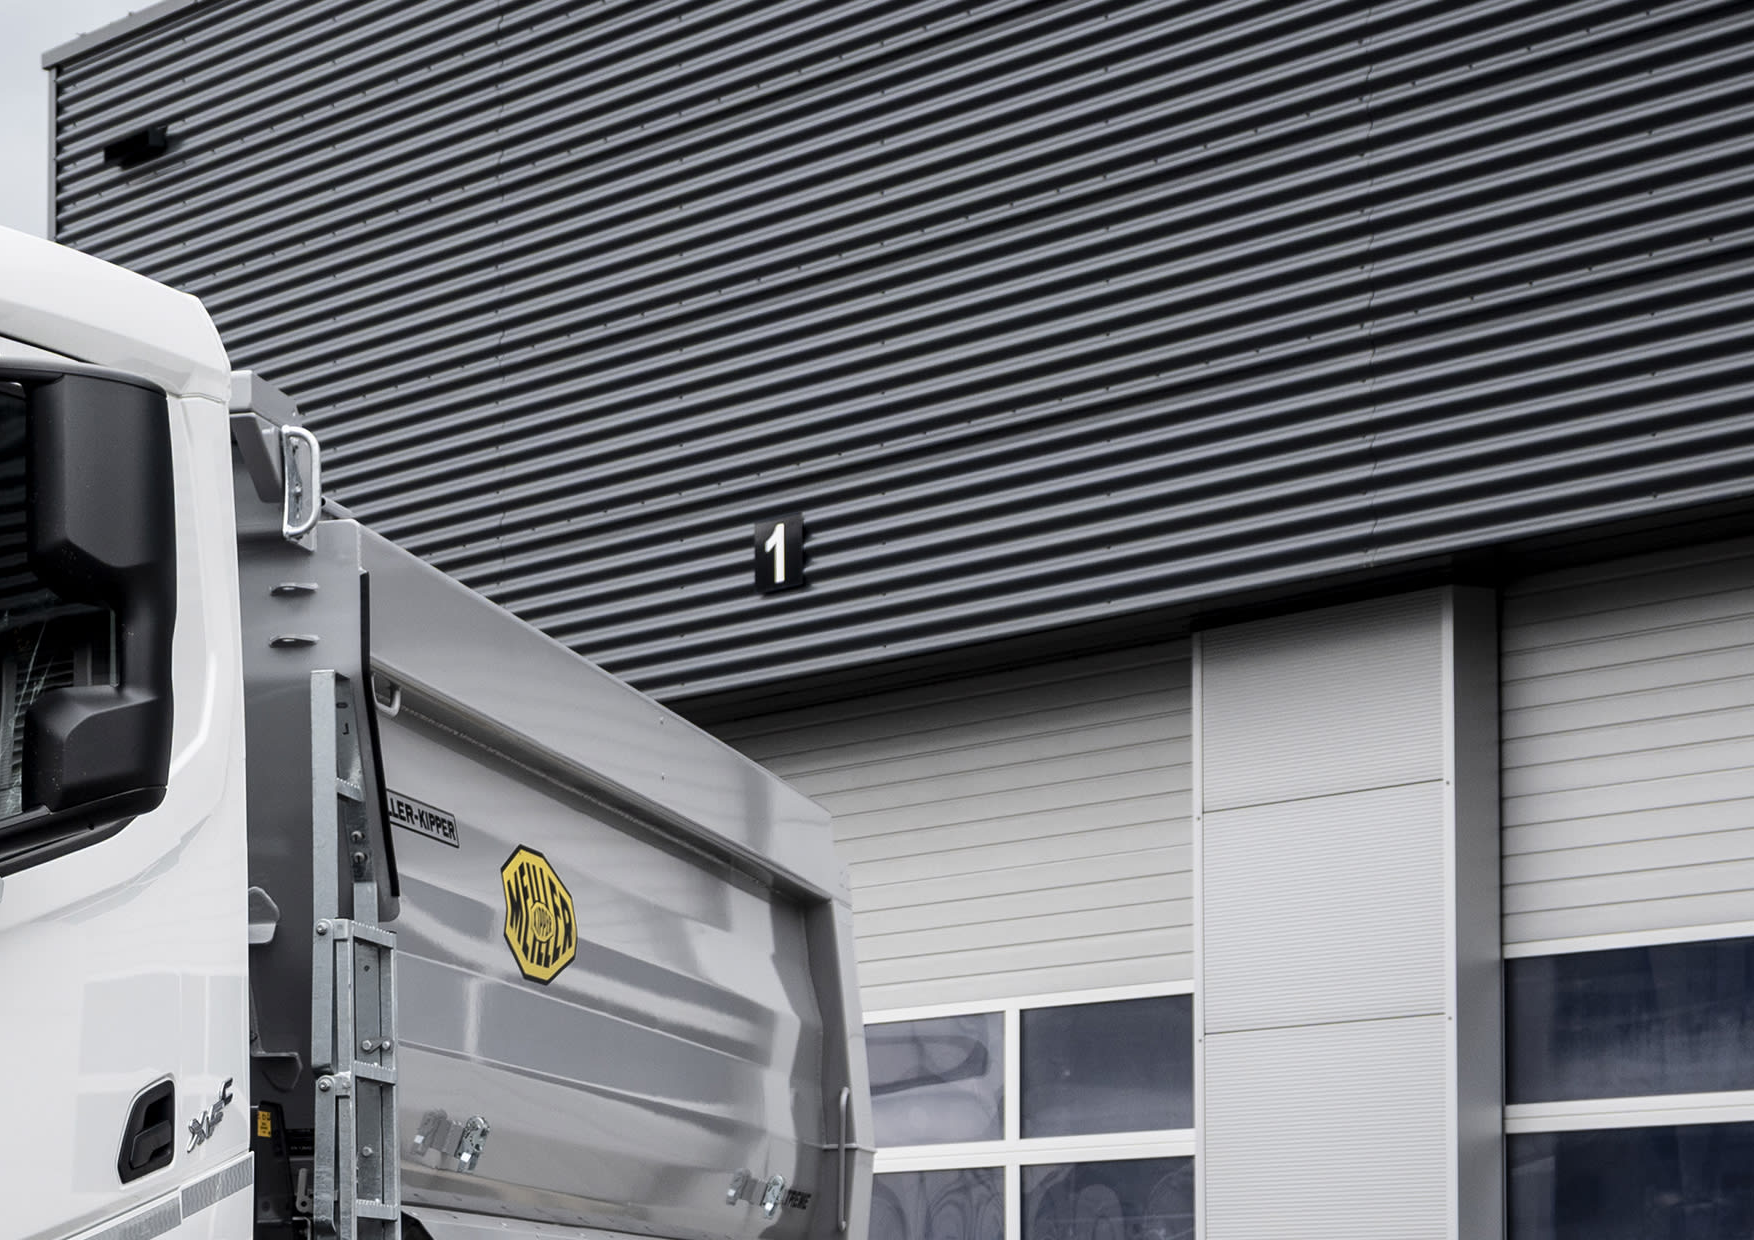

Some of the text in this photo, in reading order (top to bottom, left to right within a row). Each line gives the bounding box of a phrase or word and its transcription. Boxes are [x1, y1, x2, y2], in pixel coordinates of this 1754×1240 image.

[764, 523, 785, 583] 1
[388, 797, 456, 841] LER-KIPPER
[507, 861, 574, 968] MEILLER
